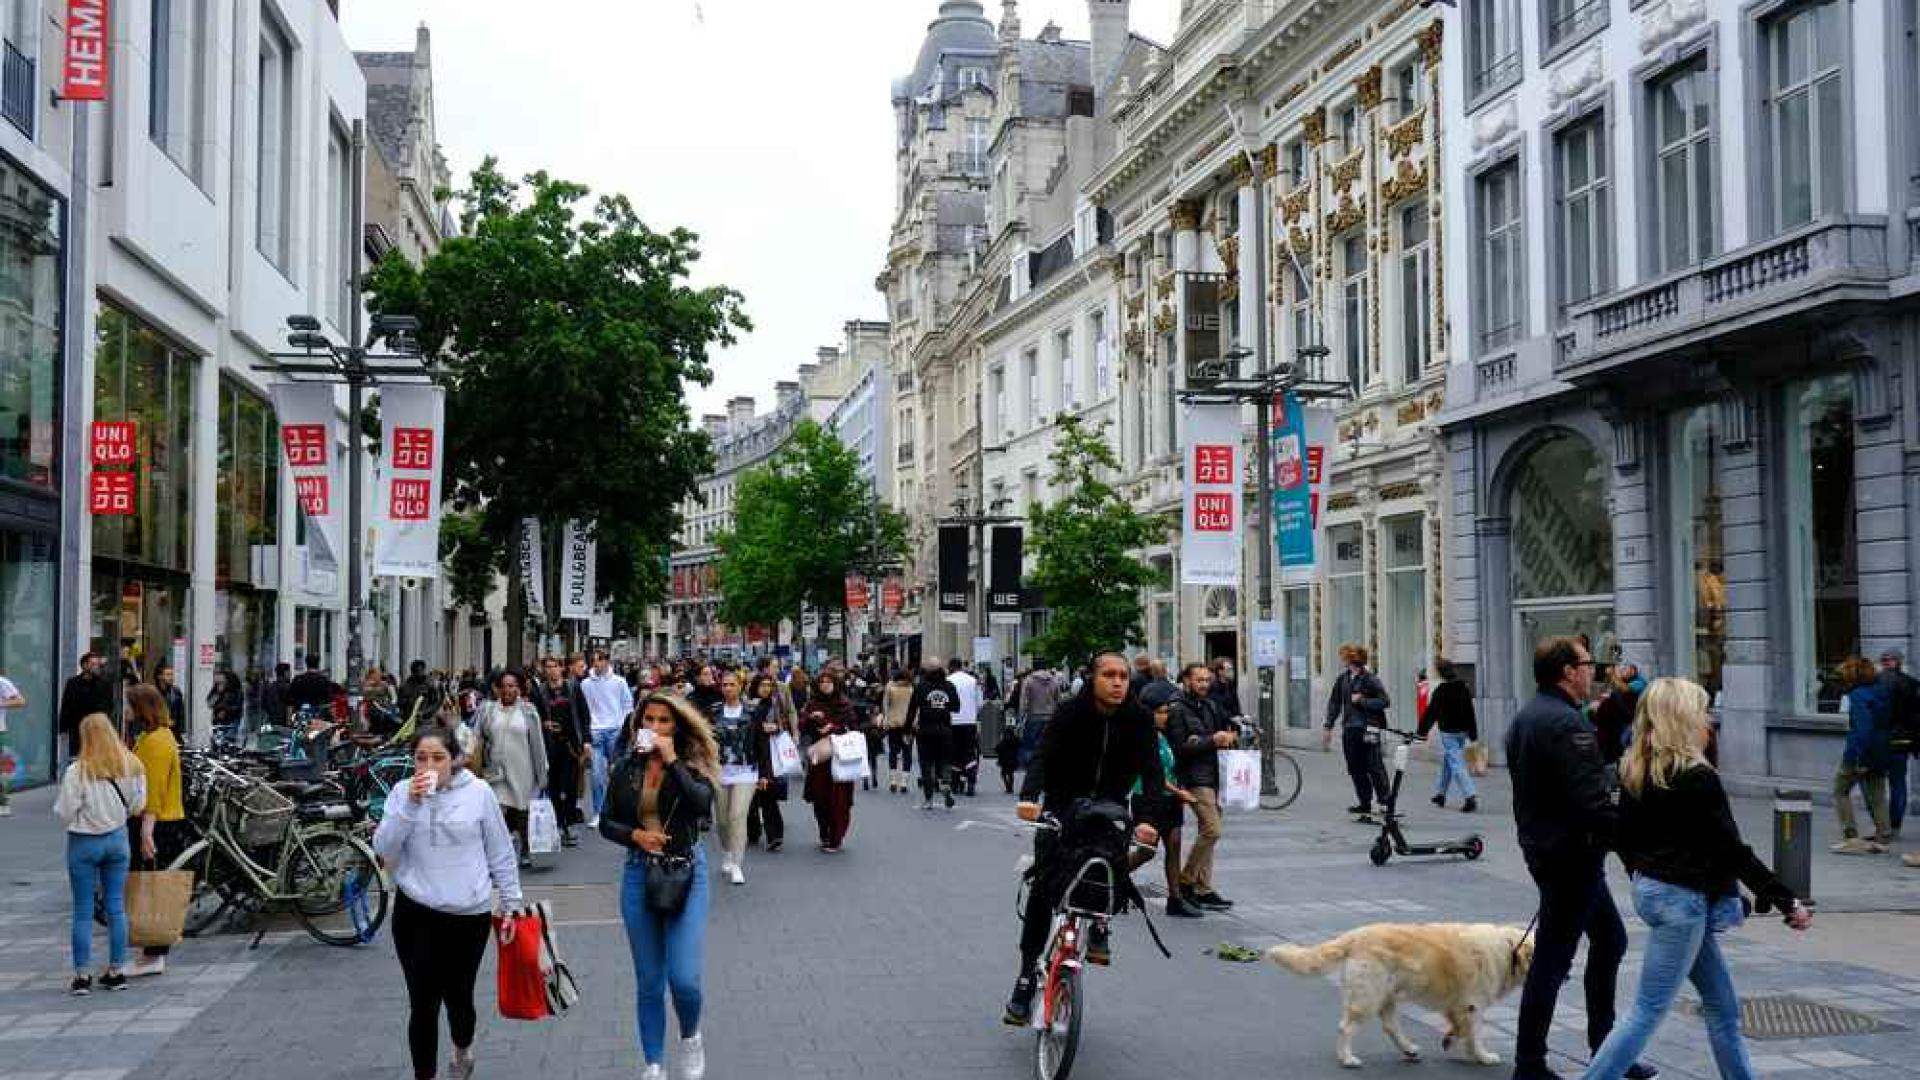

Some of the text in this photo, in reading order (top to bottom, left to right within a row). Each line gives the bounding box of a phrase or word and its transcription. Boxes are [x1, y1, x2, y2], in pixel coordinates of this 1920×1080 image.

[71, 0, 102, 86] HEM
[96, 426, 128, 441] UNI
[96, 444, 130, 460] QLO
[396, 483, 424, 498] UNI
[304, 500, 324, 512] LO
[394, 500, 424, 515] QLO
[1199, 498, 1226, 511] UNI
[1199, 514, 1228, 528] QLO
[943, 593, 965, 605] WE
[994, 594, 1019, 605] WE
